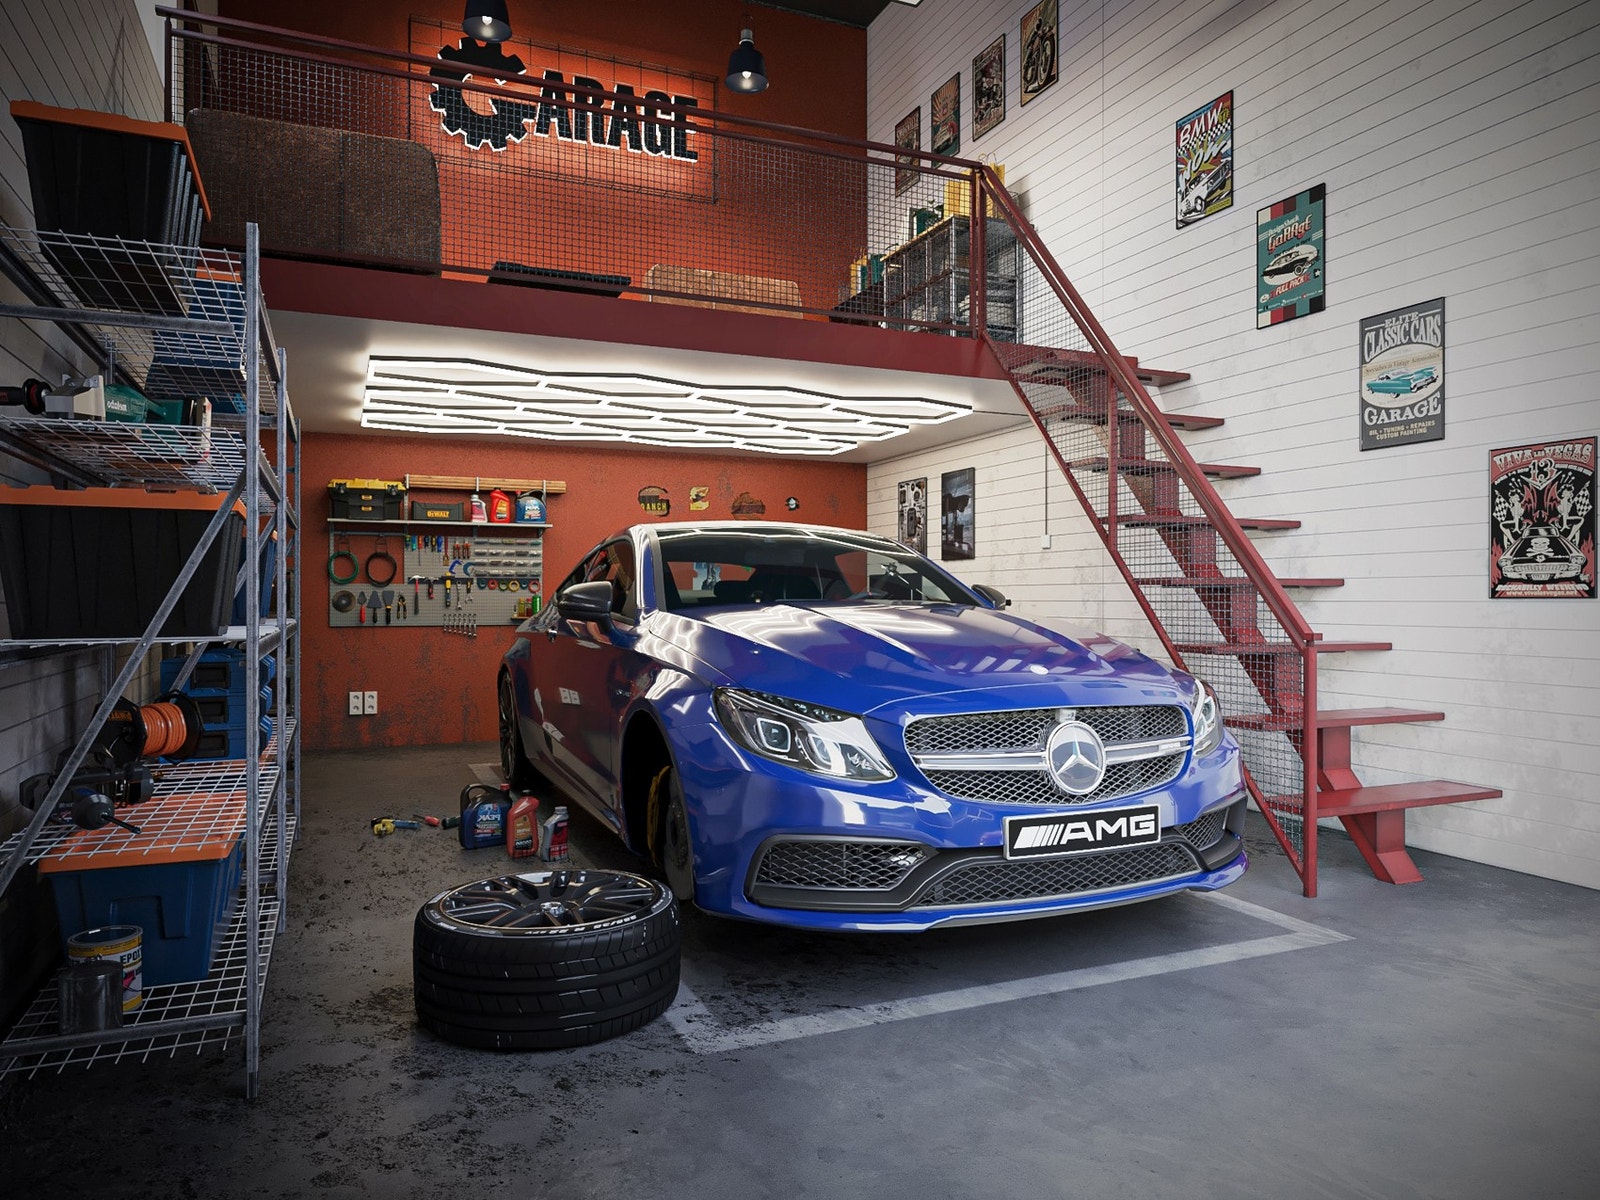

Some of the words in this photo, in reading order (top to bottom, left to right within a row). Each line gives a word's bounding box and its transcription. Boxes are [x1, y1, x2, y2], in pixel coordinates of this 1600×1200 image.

[1180, 102, 1223, 148] BMW
[1384, 311, 1419, 328] ELITE
[1364, 322, 1410, 363] CLASSIC
[1410, 314, 1442, 347] CARS
[1364, 391, 1442, 426] GARAGE
[1376, 431, 1400, 441] CUSTOM
[1400, 427, 1427, 437] PAINTING
[1383, 425, 1405, 433] TUNING
[1410, 420, 1436, 430] REPAIRS
[1493, 449, 1533, 472] VIVA
[1544, 444, 1593, 464] VEGAS
[1529, 457, 1558, 483] 13
